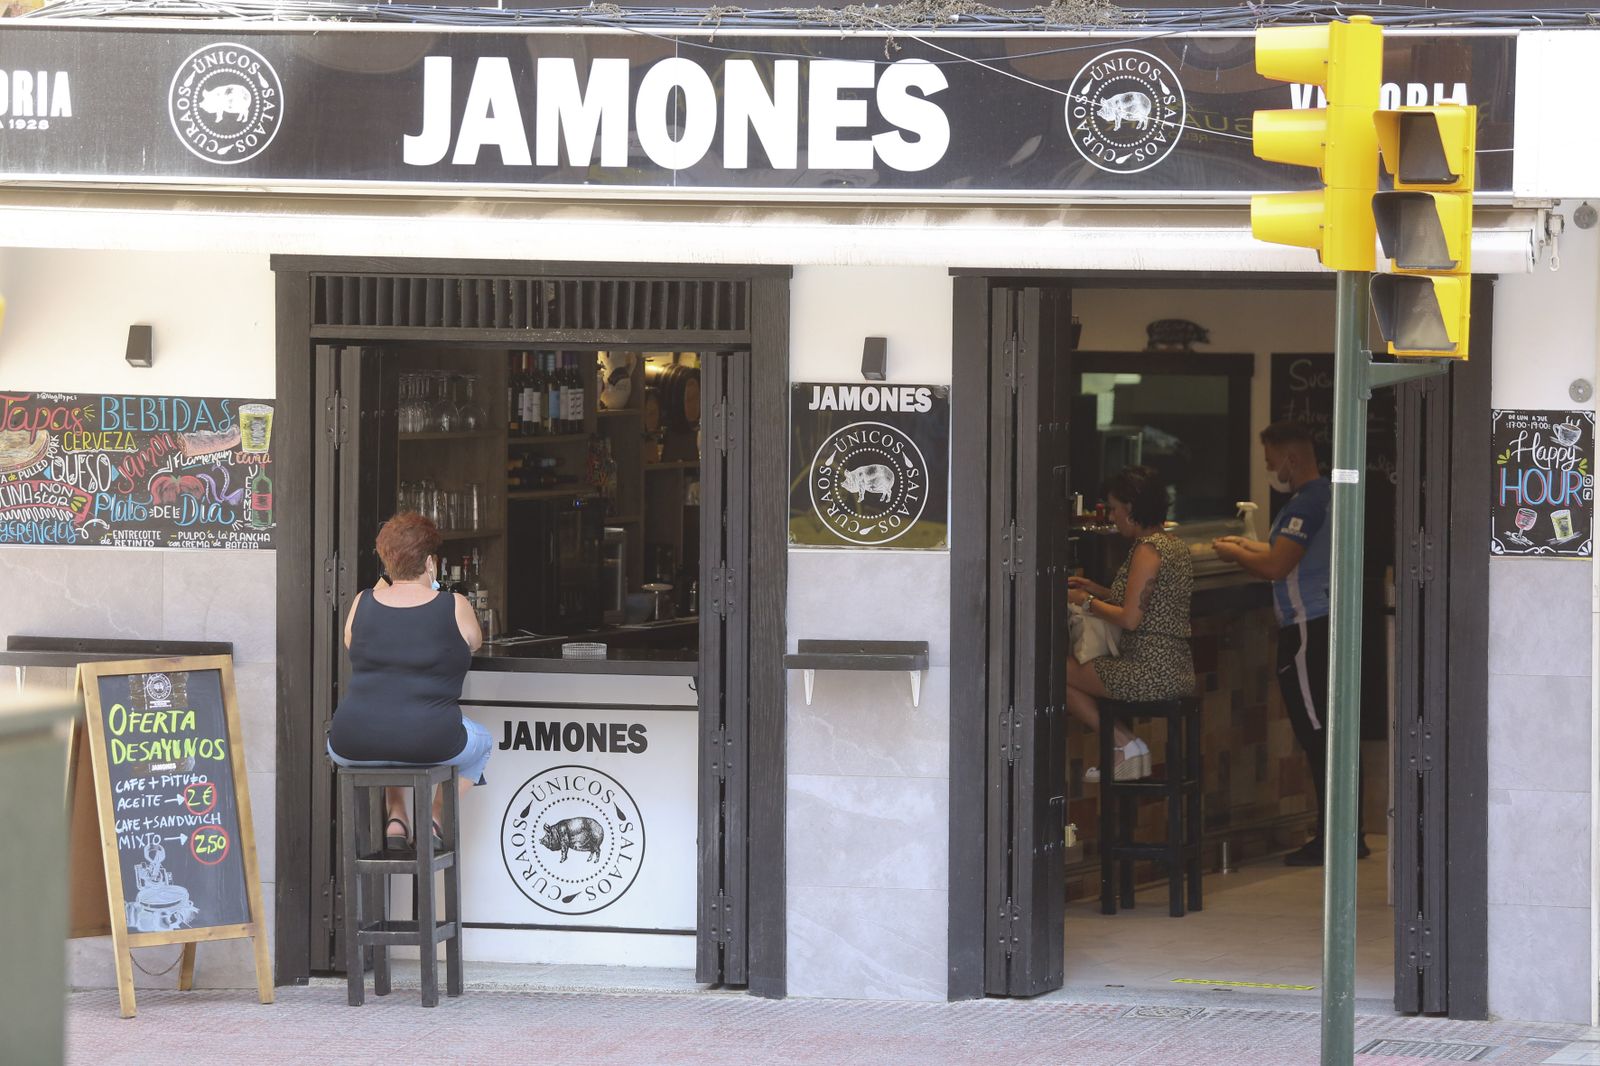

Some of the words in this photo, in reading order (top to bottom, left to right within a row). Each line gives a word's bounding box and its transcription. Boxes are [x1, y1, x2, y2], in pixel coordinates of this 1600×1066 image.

[194, 51, 261, 75] ÚNICOS
[1090, 57, 1161, 81] ÚNICOS
[9, 119, 49, 130] 1928
[177, 86, 218, 152] CURAOS
[236, 87, 275, 153] SALAOS
[403, 56, 951, 172] JAMONES
[1074, 94, 1116, 162] CURAOS
[1135, 95, 1176, 162] SALAOS
[101, 396, 236, 433] BEBIDAS
[808, 386, 933, 413] JAMONES
[64, 431, 137, 451] CERVEZA
[834, 430, 904, 454] ÚNICOS
[1509, 430, 1583, 472] Happy
[18, 460, 48, 481] PULLED
[51, 454, 112, 494] QUESO
[1500, 467, 1584, 507] HOUR
[154, 505, 178, 518] DEL
[817, 465, 860, 533] CURAOS
[878, 468, 920, 533] SALAOS
[177, 531, 206, 541] PULPO
[229, 532, 271, 542] PLANCHA
[181, 540, 210, 548] CREMA
[109, 703, 196, 736] OFERTA
[111, 737, 225, 764] DESAYUNOS
[499, 720, 648, 754] JAMONES
[115, 777, 146, 793] CAFE
[529, 775, 616, 805] ÚNICOS
[511, 818, 562, 901] CURAOS
[585, 821, 635, 901] SALAOS
